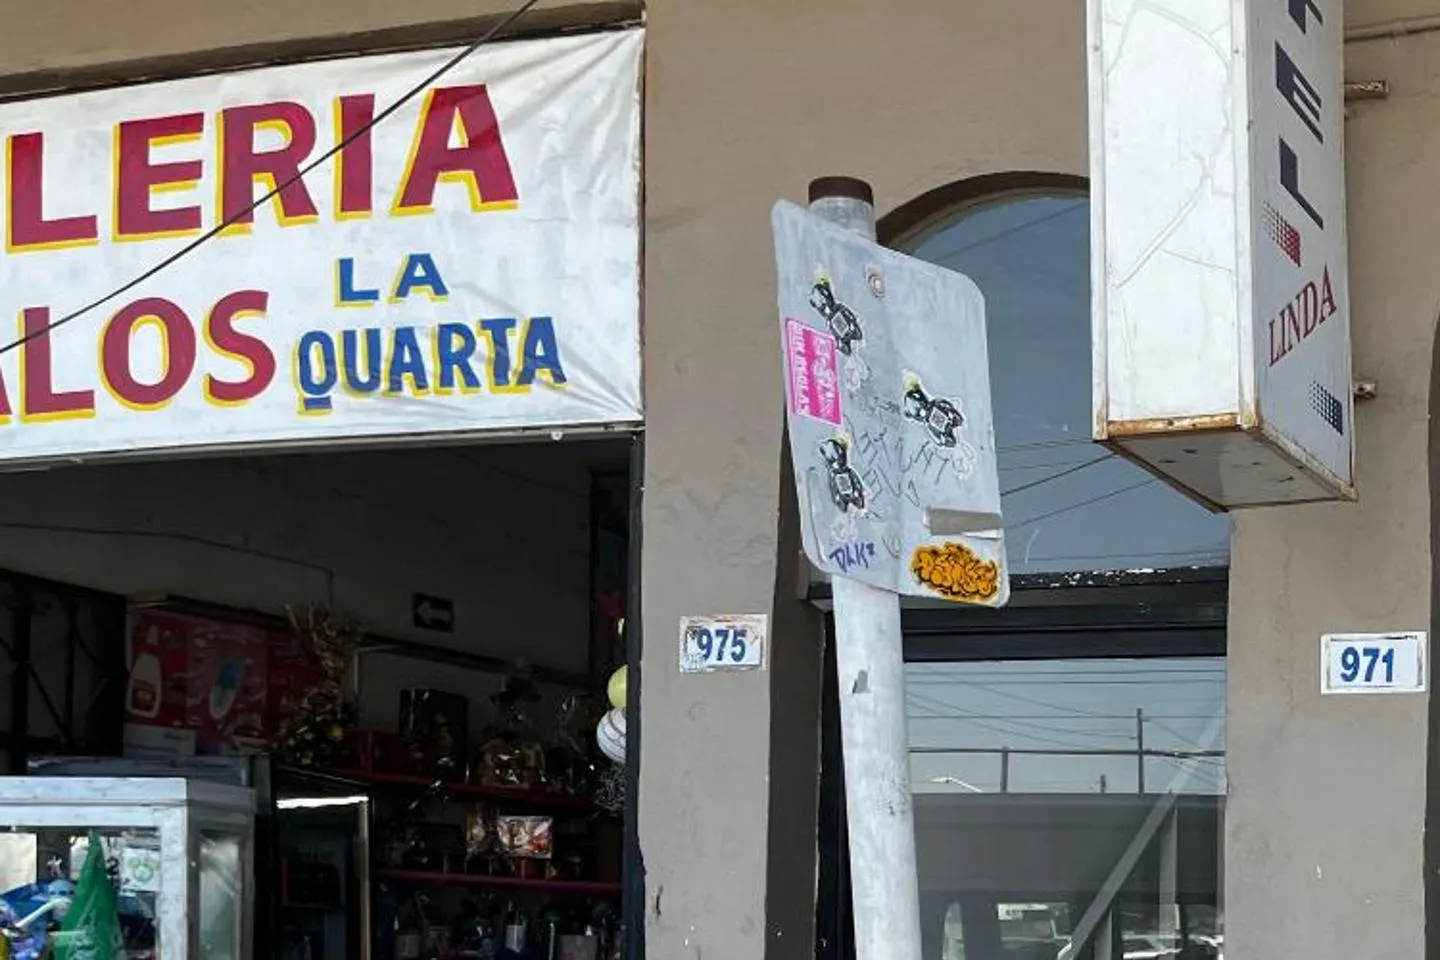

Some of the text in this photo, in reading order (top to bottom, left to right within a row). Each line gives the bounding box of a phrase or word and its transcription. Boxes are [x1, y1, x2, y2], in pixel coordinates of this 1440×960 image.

[6, 83, 519, 252] LERIA
[334, 252, 449, 307] LA
[1269, 262, 1337, 368] LINDA
[0, 289, 277, 424] LOS
[292, 315, 568, 415] QUARTA
[696, 627, 748, 663] 975
[1340, 646, 1395, 683] 971
